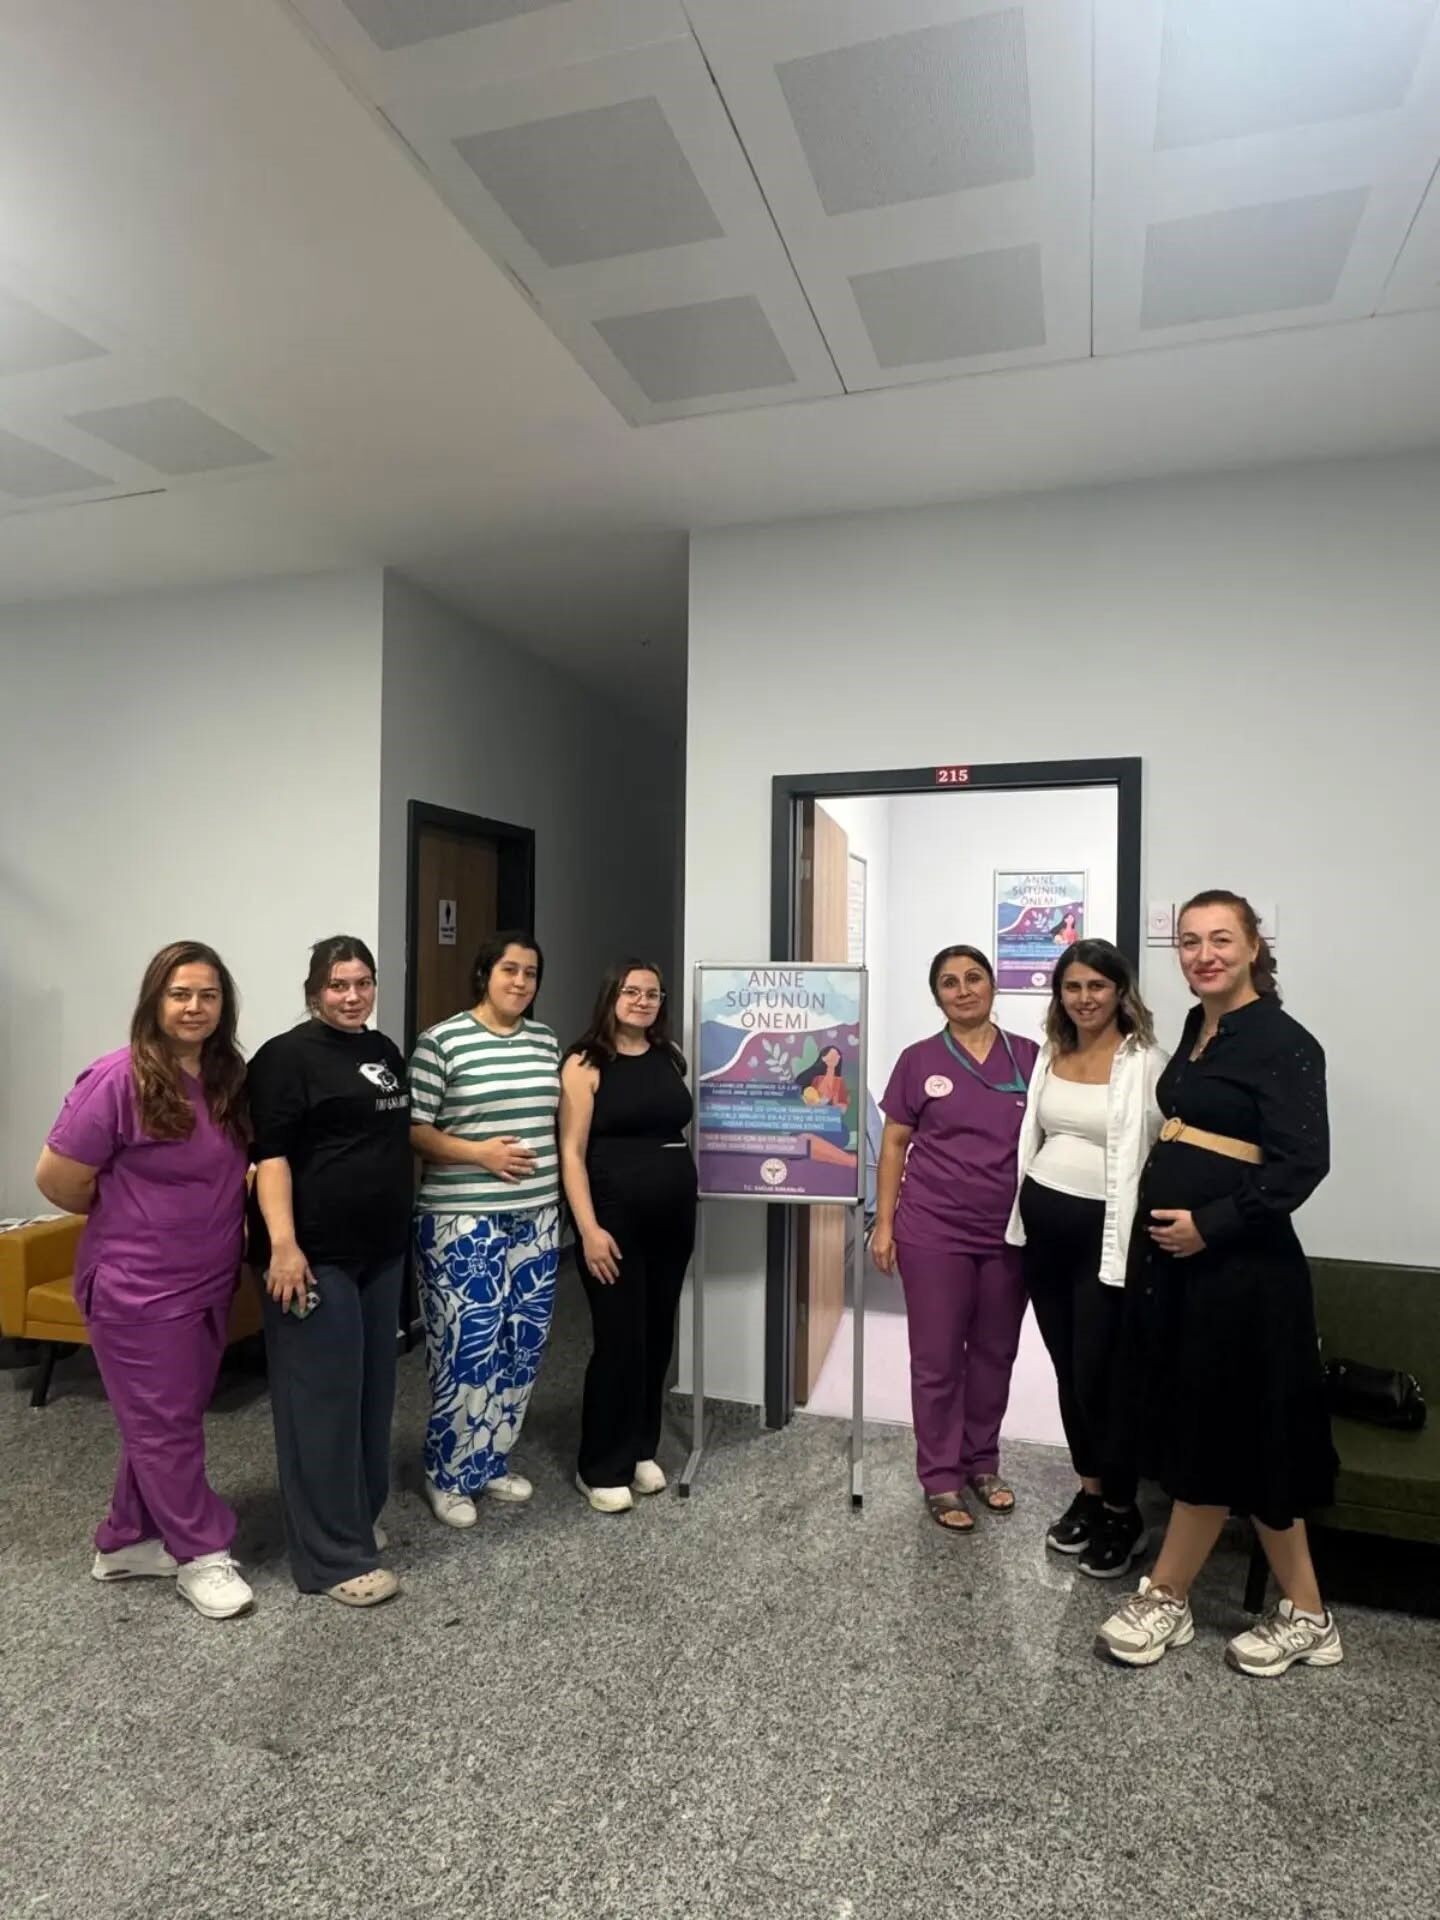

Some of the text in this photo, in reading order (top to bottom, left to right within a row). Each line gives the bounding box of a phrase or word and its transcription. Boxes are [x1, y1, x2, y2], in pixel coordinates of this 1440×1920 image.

[938, 769, 969, 783] 215
[748, 971, 805, 988] ANNE
[726, 988, 826, 1009] SÜTÜNÜN
[741, 1009, 808, 1029] ÖNEMİ
